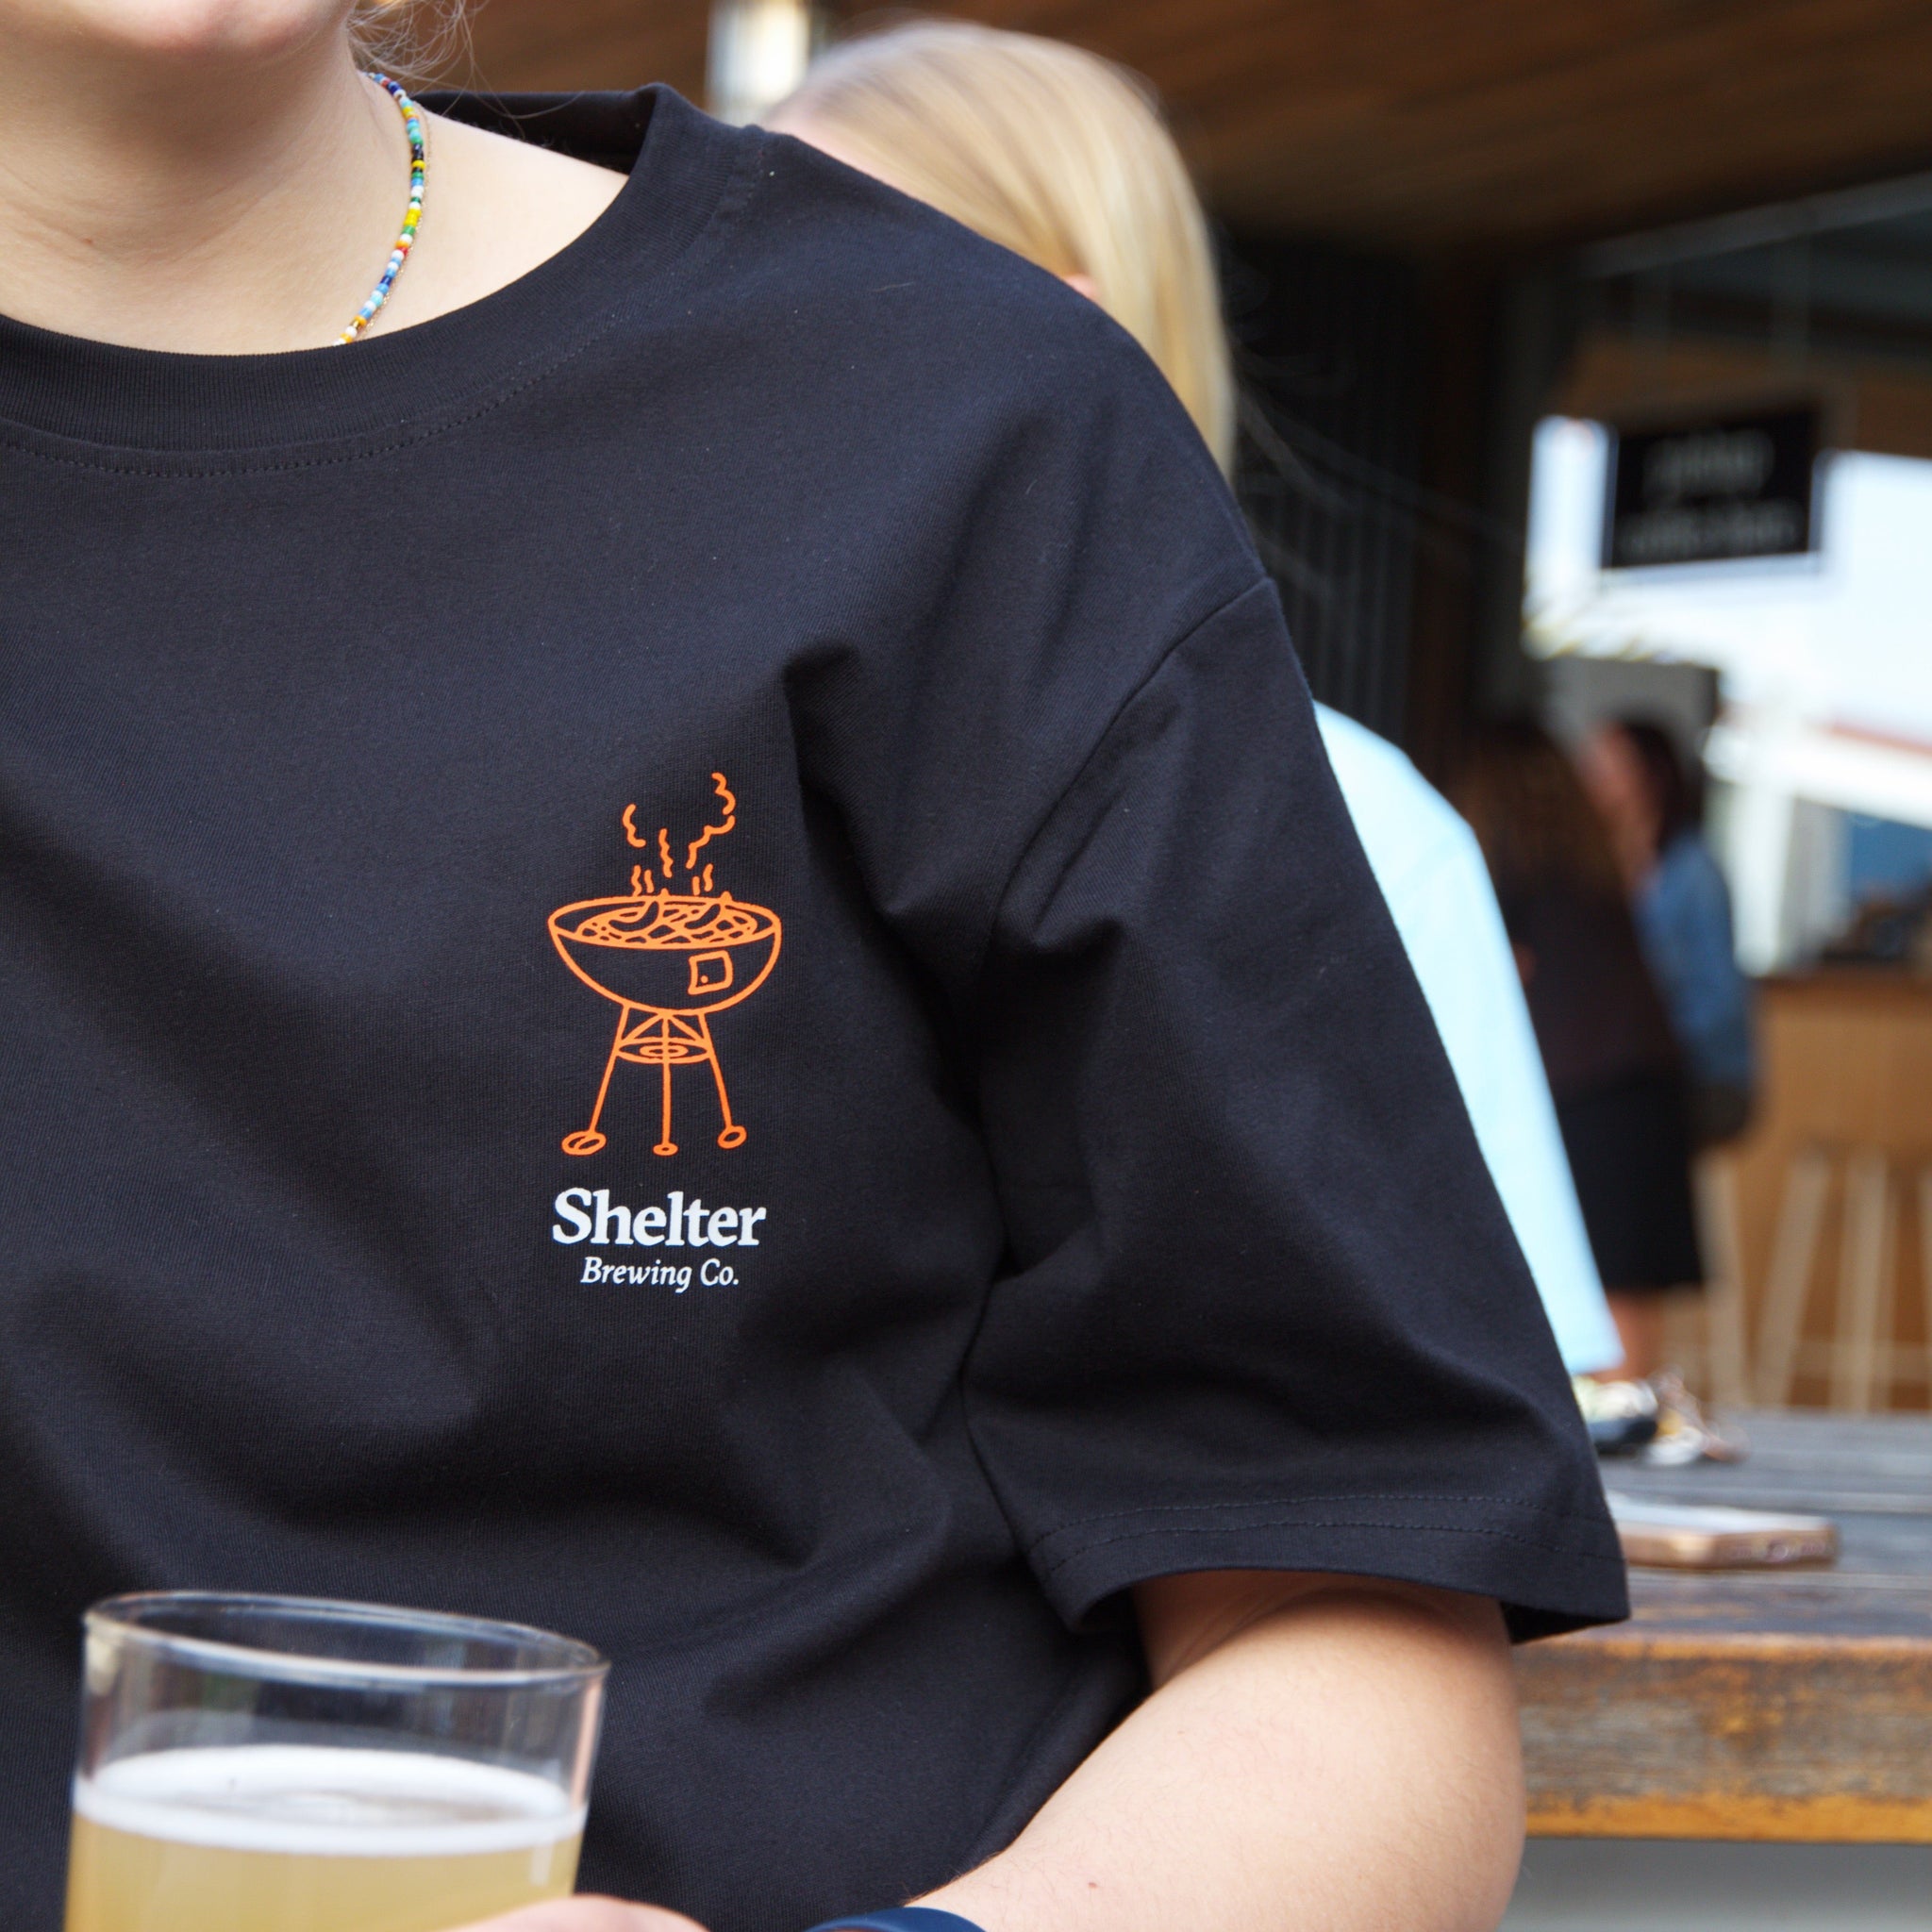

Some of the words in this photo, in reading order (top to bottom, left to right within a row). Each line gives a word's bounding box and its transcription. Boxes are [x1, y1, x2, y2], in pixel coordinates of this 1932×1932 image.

[552, 1187, 767, 1247] Shelter
[579, 1256, 693, 1293] Brewing
[700, 1257, 740, 1286] Co.
